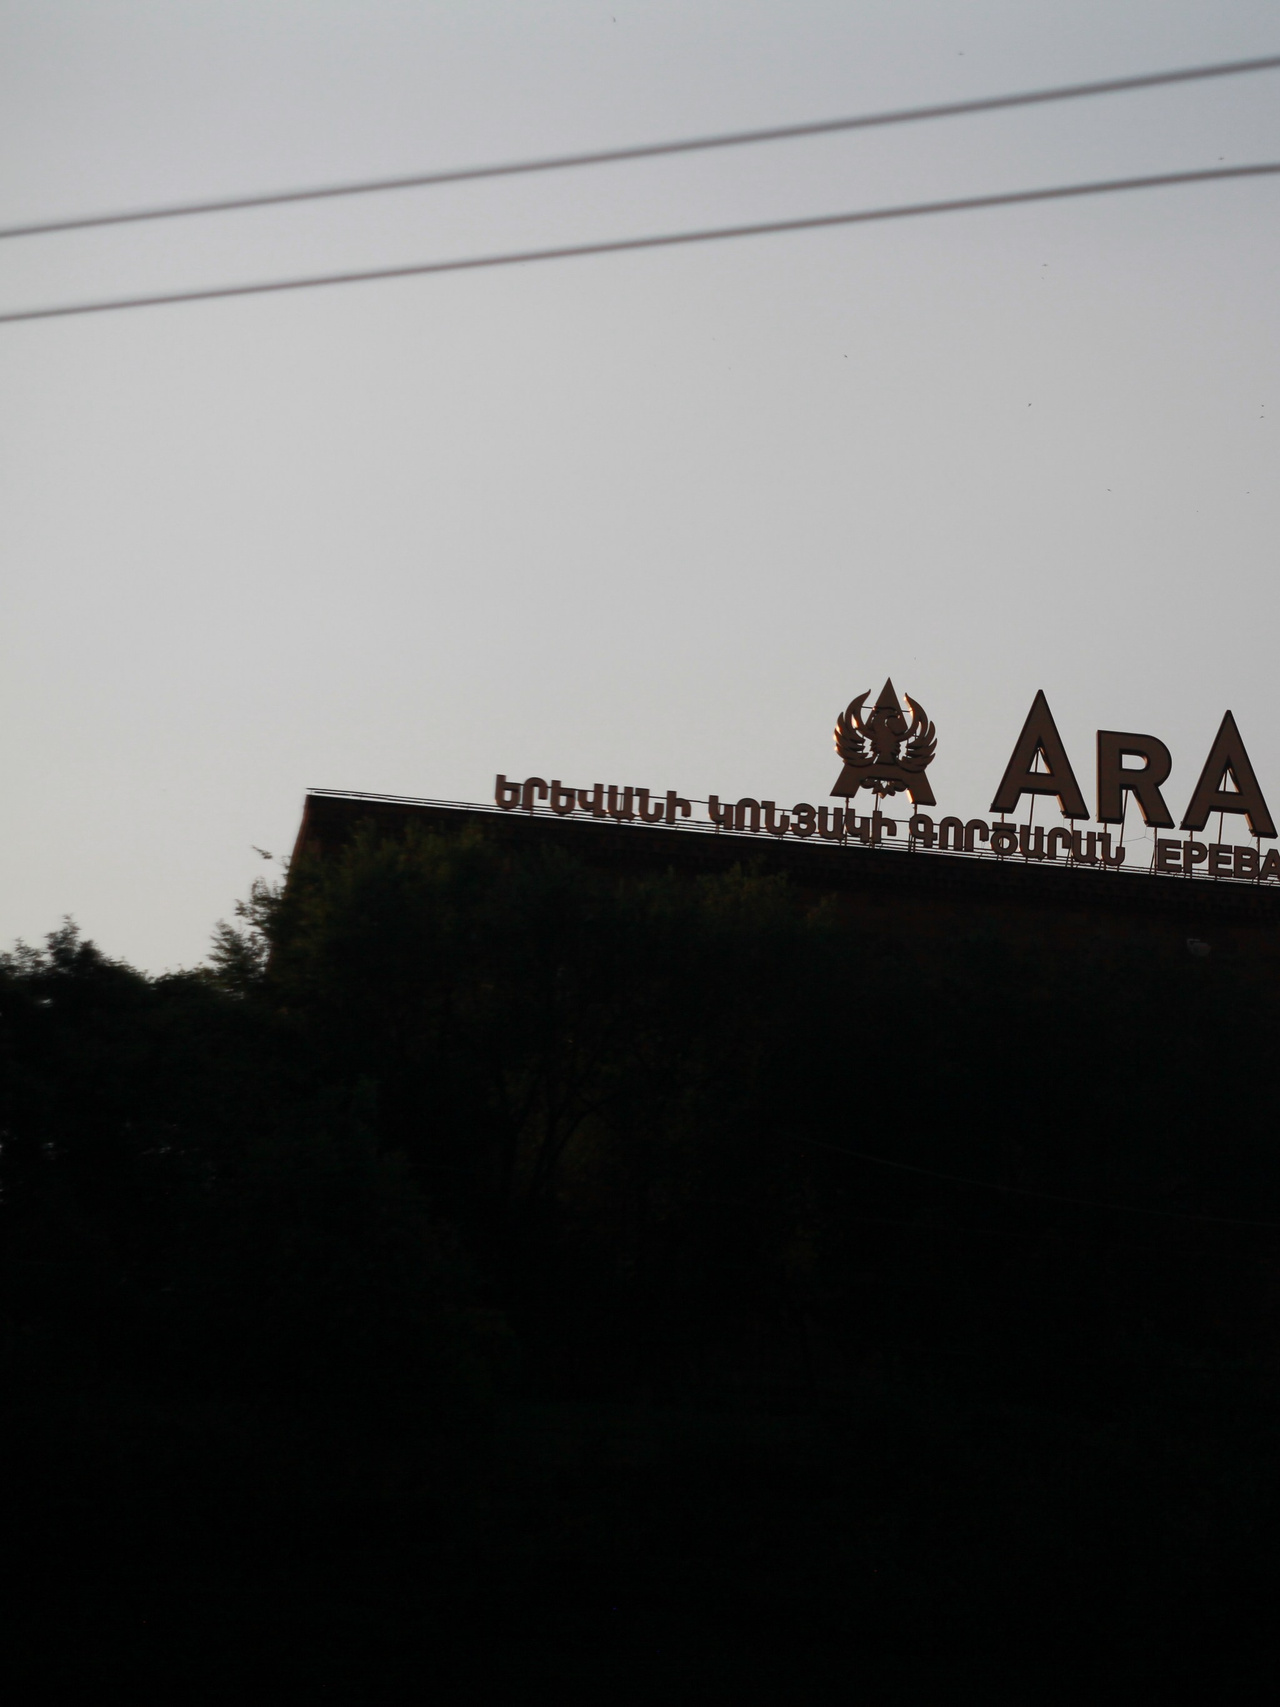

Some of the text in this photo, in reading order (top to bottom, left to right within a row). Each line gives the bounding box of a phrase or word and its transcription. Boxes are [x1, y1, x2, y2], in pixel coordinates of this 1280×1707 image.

[495, 774, 1125, 865] ԵՐԵՎԱՆԻ ԿՈՆՅԱԿԻ ԳՈՐԾԱՐԱՆ
